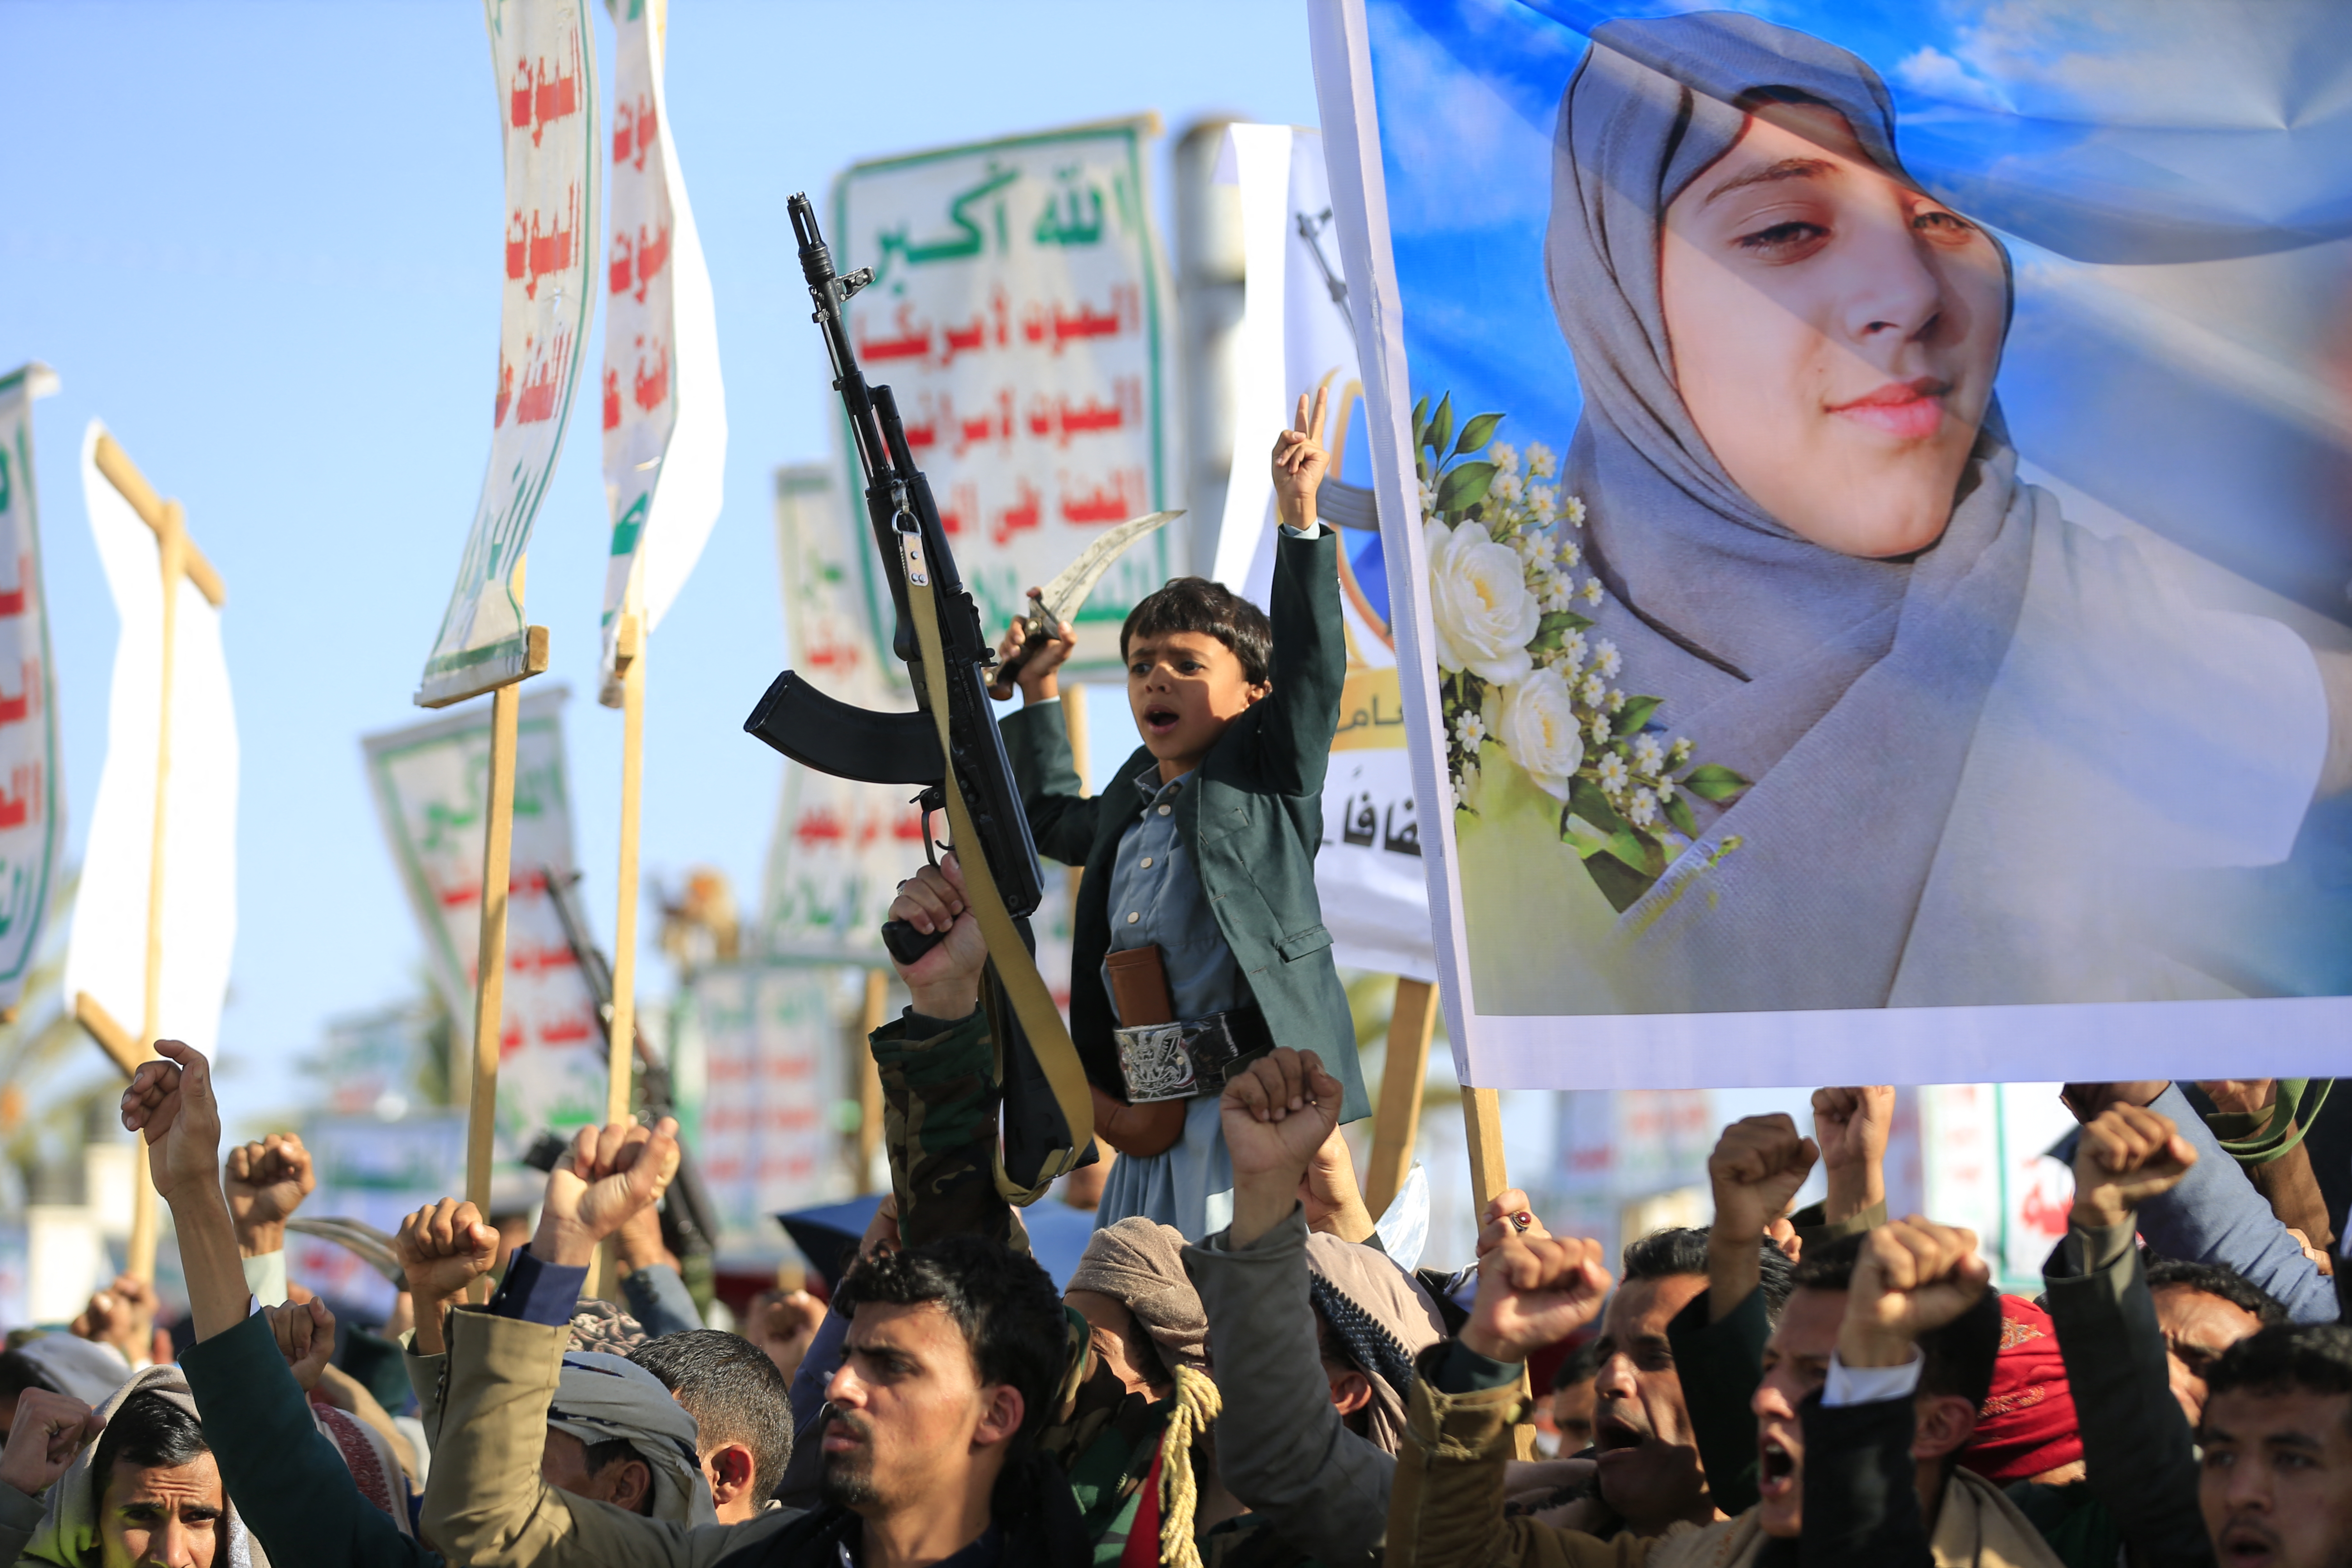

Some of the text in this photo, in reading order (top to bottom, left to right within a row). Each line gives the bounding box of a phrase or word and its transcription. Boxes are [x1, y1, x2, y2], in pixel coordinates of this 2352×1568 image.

[511, 26, 583, 149] الموت
[505, 176, 581, 300] الموت
[867, 159, 1138, 296] الله أكبر
[1022, 278, 1141, 358] الموت
[1026, 376, 1142, 449] الموت
